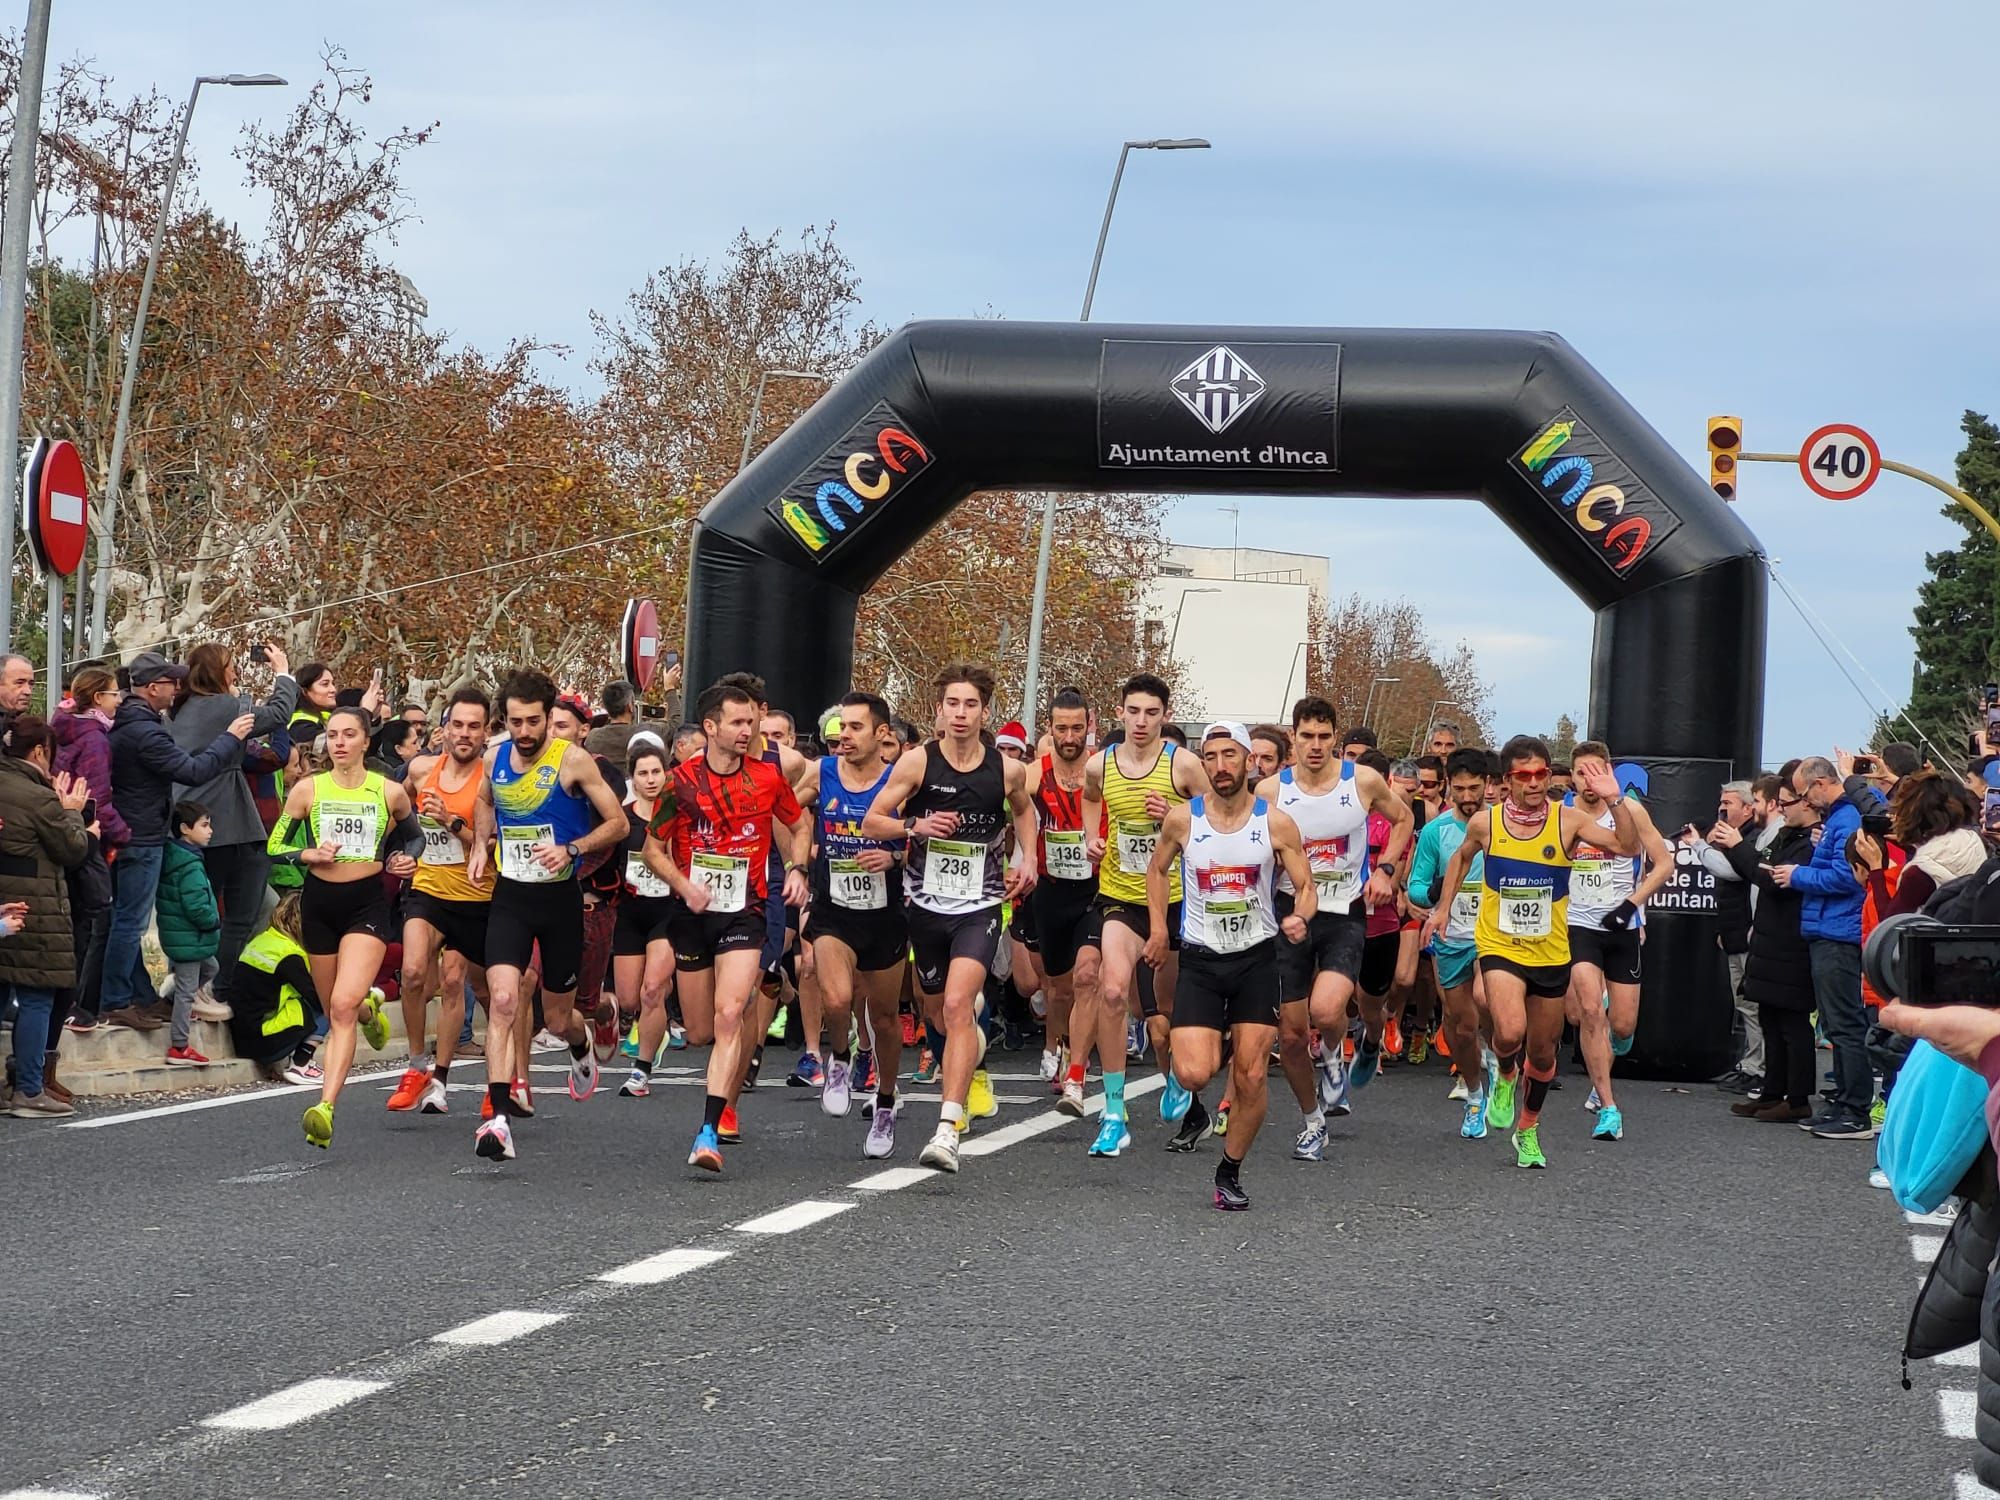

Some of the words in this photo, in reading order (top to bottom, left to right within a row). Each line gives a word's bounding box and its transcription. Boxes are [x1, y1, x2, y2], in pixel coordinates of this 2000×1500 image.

[1108, 443, 1251, 465] Ajuntament
[1258, 445, 1329, 465] d'Inca
[1813, 444, 1866, 479] 40
[335, 817, 363, 834] 589
[1056, 846, 1081, 861] 136
[1129, 838, 1156, 853] 253
[939, 857, 970, 877] 238
[704, 871, 733, 890] 213
[843, 875, 872, 892] 108
[1210, 872, 1247, 887] CAMPER
[1507, 877, 1527, 886] THB
[1527, 876, 1554, 886] hotels
[1578, 874, 1602, 888] 750
[1665, 868, 1691, 888] de
[1697, 870, 1715, 889] la
[1647, 890, 1718, 909] untan
[1512, 902, 1540, 918] 492
[1219, 914, 1249, 933] 157
